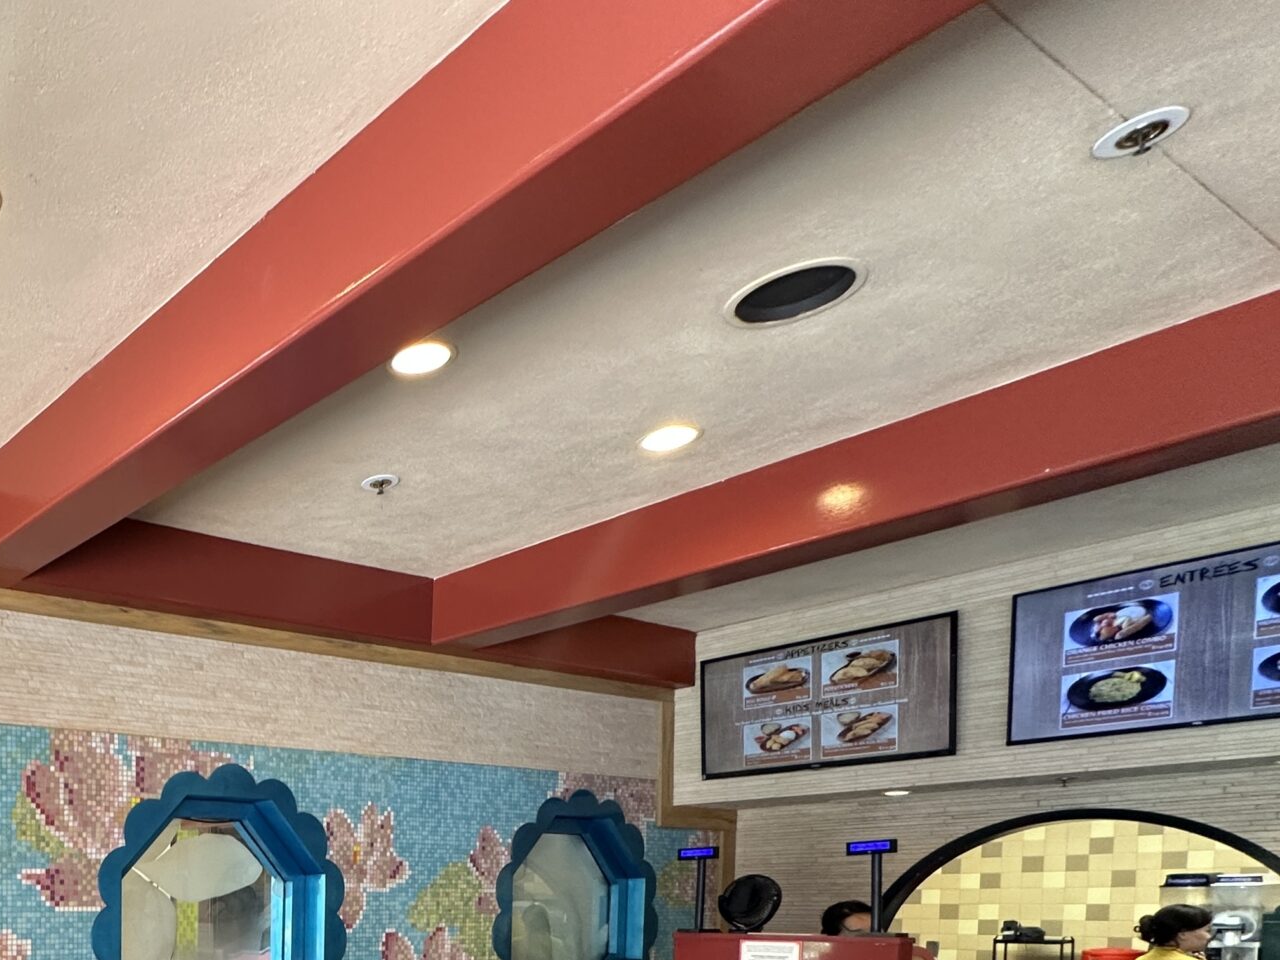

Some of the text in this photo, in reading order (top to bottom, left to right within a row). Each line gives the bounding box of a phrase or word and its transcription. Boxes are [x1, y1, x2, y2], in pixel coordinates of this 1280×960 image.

[784, 640, 850, 659] APPETIZERS
[785, 702, 810, 715] KIDS
[815, 697, 850, 711] MEALS
